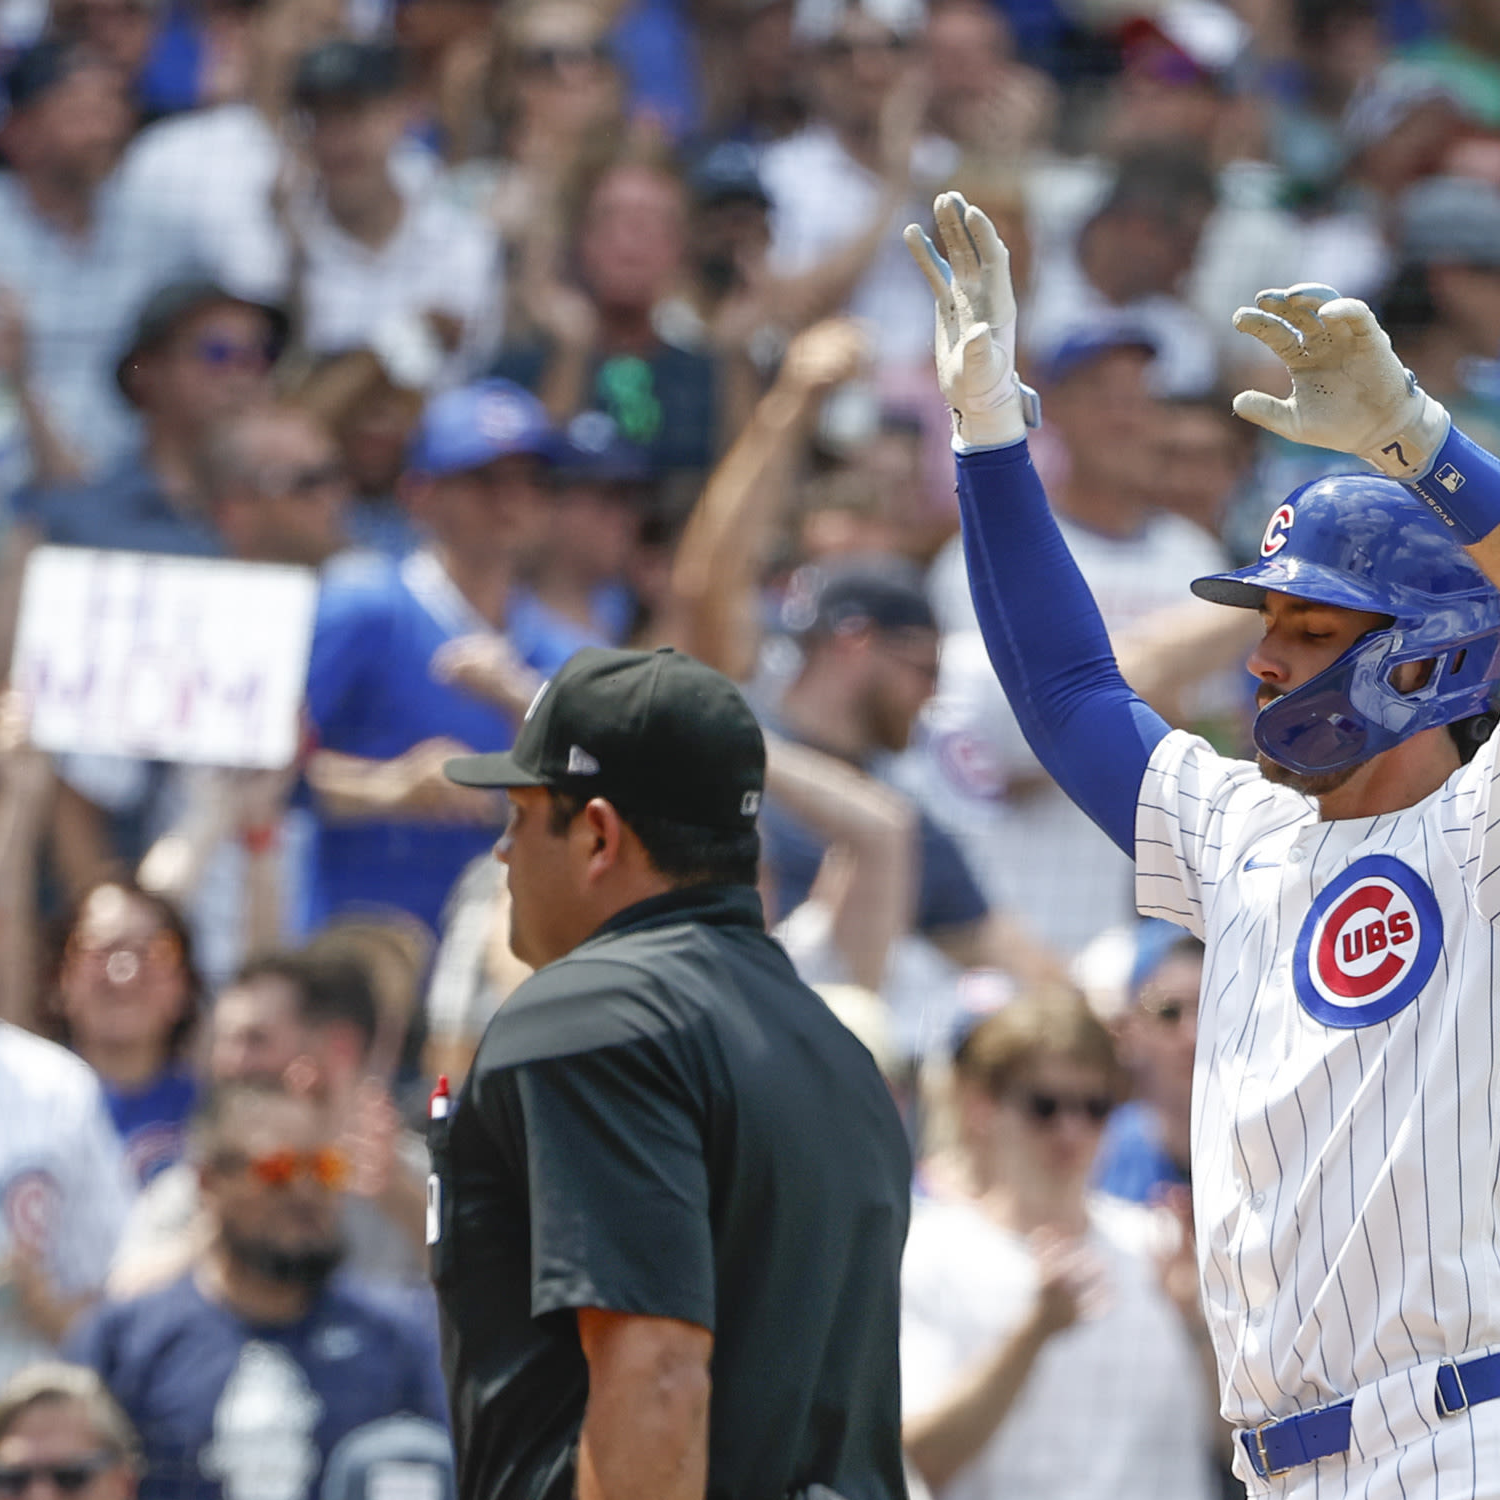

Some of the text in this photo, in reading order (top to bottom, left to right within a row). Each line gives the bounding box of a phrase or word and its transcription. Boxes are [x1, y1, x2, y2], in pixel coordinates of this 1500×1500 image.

[1381, 441, 1409, 467] 7
[1260, 503, 1295, 558] C
[1317, 885, 1414, 998] CUBS
